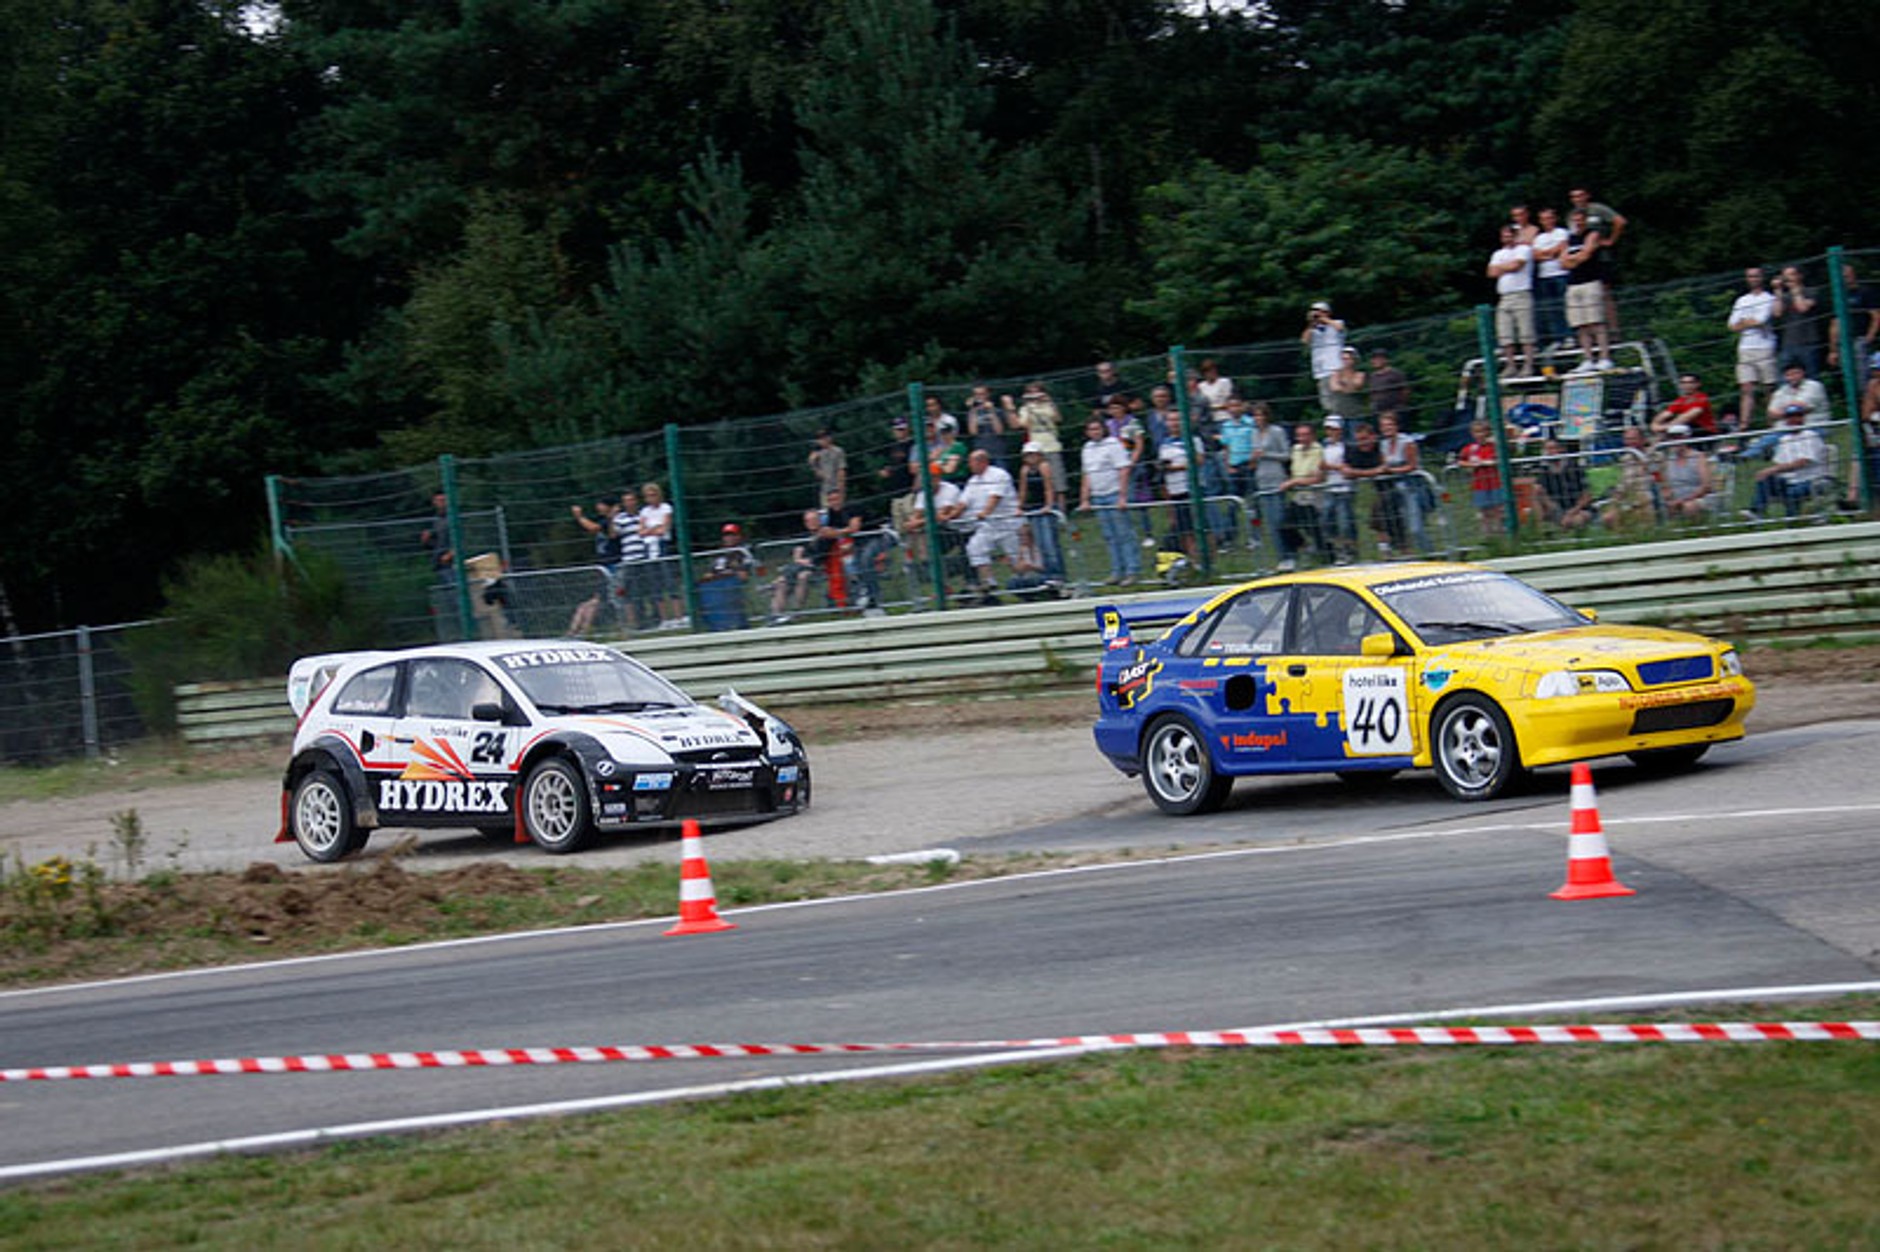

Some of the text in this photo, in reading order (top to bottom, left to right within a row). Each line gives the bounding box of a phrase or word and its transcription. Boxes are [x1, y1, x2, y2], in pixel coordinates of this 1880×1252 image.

[502, 650, 613, 668] HYDREX
[1353, 697, 1401, 745] 40
[471, 731, 506, 764] 24
[679, 735, 744, 748] HYDREX
[379, 779, 509, 811] HYDREX
